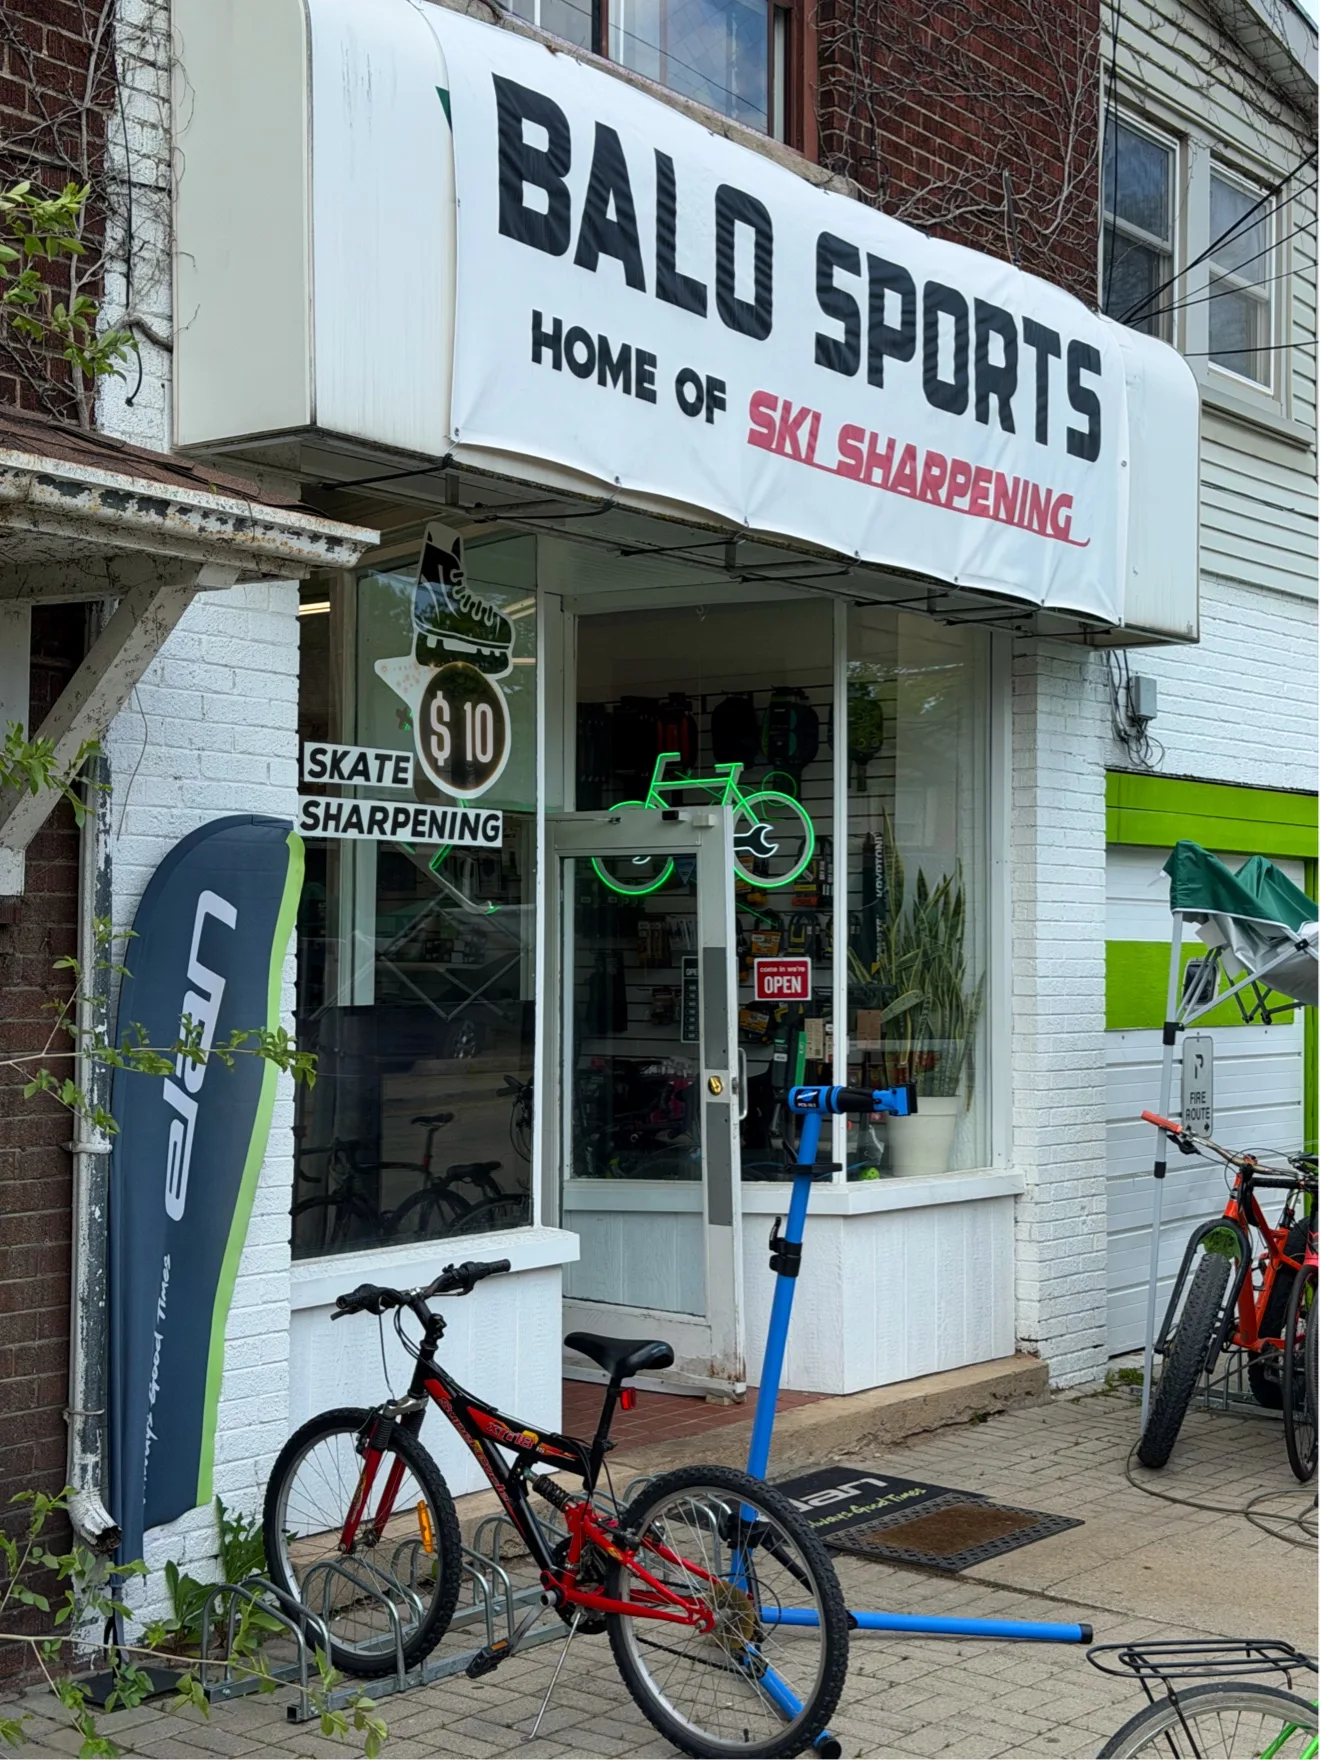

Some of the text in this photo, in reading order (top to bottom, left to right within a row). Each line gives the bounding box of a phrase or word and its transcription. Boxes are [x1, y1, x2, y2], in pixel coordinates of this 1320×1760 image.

[491, 72, 1102, 463] BALO SPORTS
[531, 309, 727, 425] HOME OF
[747, 390, 1079, 539] SKI SHARPENING
[463, 701, 494, 763] 10
[307, 747, 411, 785] SKATE
[300, 800, 500, 842] SHARPENING
[685, 968, 699, 976] OPE
[764, 975, 802, 994] OPEN
[163, 889, 238, 1222] elan
[1185, 1107, 1210, 1121] ROUTE
[1189, 1091, 1206, 1105] FIRE
[157, 1253, 171, 1324] Times
